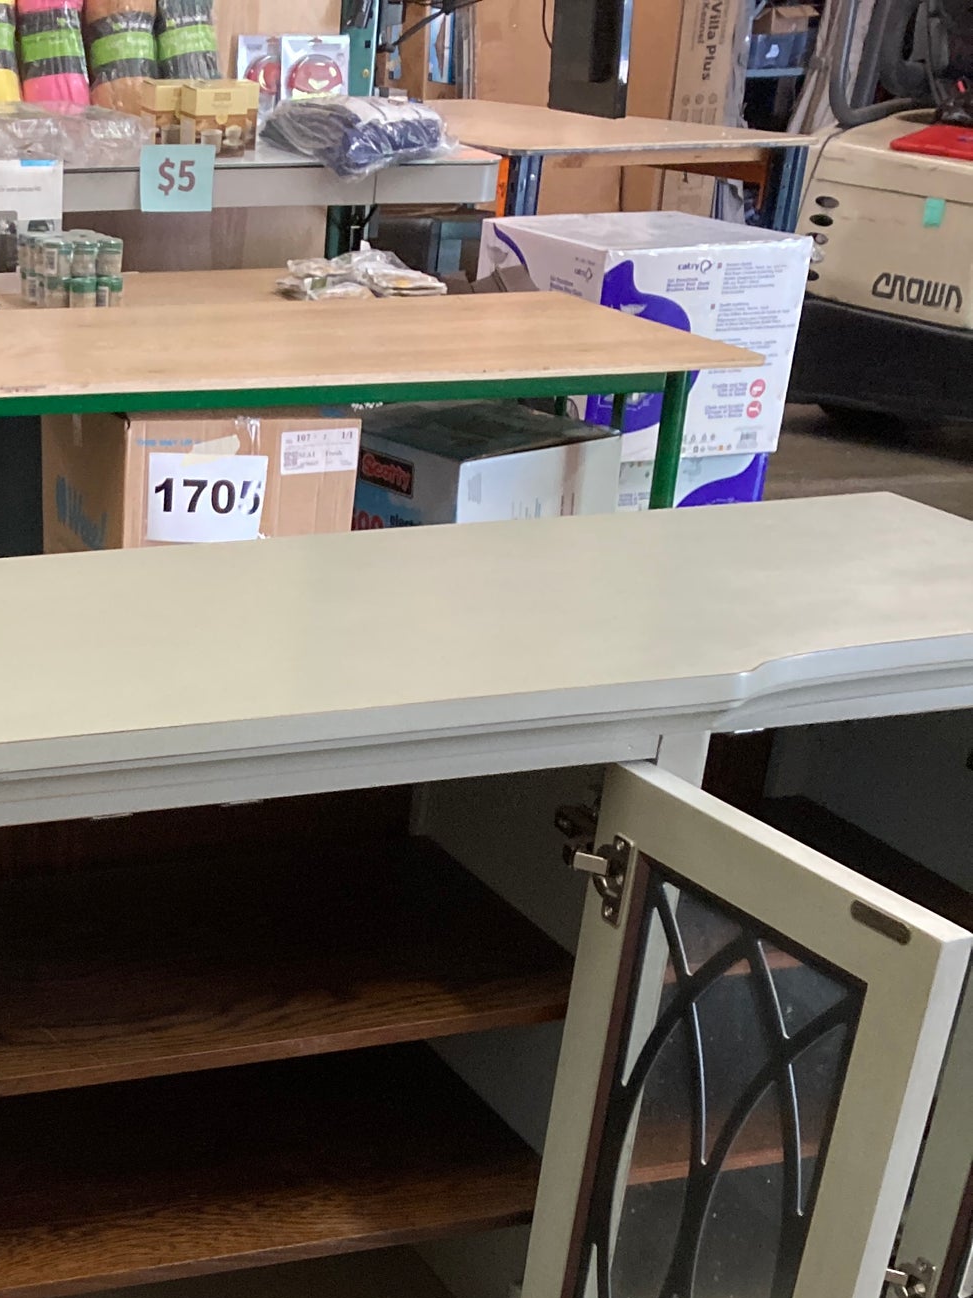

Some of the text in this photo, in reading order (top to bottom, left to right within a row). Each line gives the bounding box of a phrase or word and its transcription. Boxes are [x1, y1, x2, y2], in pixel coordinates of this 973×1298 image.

[706, 0, 724, 40] Villa
[701, 44, 717, 81] Plus
[157, 157, 196, 196] $5
[871, 271, 963, 313] CROWN
